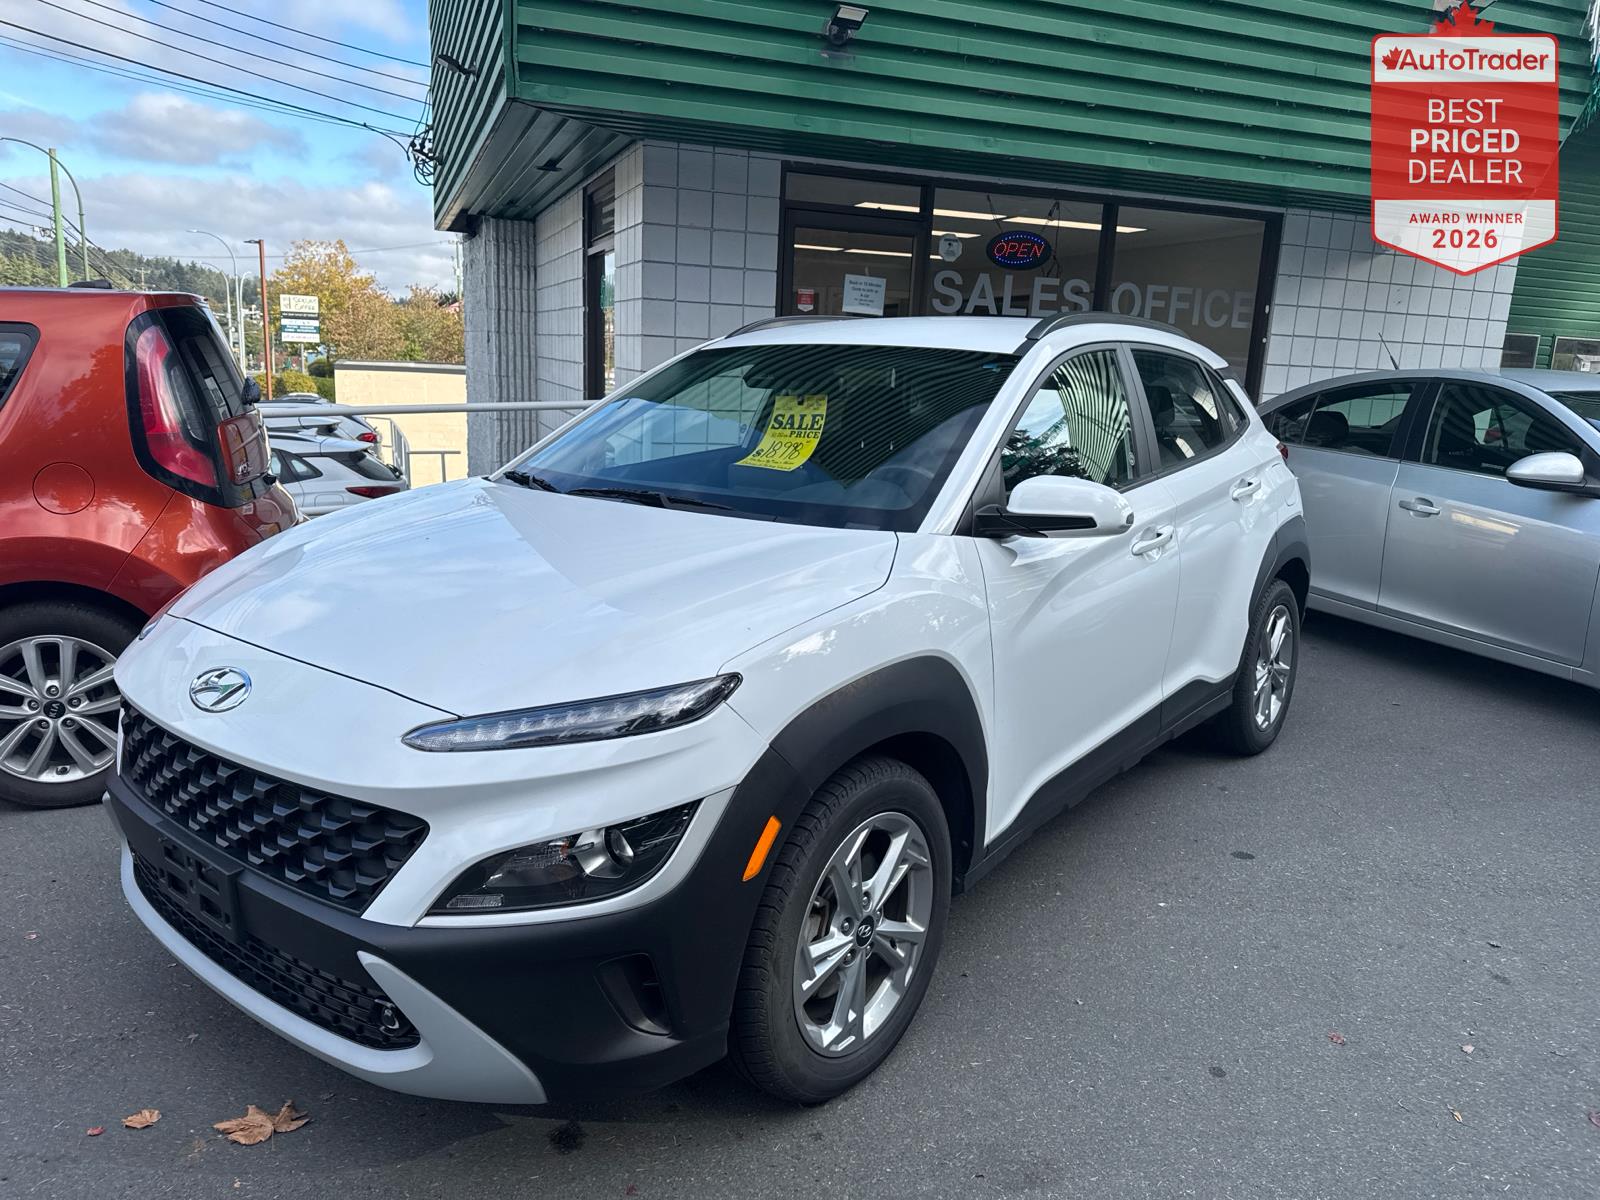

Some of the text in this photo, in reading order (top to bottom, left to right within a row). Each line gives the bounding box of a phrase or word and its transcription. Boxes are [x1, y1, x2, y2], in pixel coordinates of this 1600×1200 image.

[993, 241, 1045, 258] OPEN
[931, 270, 1091, 317] SALES
[1111, 281, 1250, 328] OFFICE
[770, 413, 825, 431] SALE
[788, 430, 821, 439] PRICE
